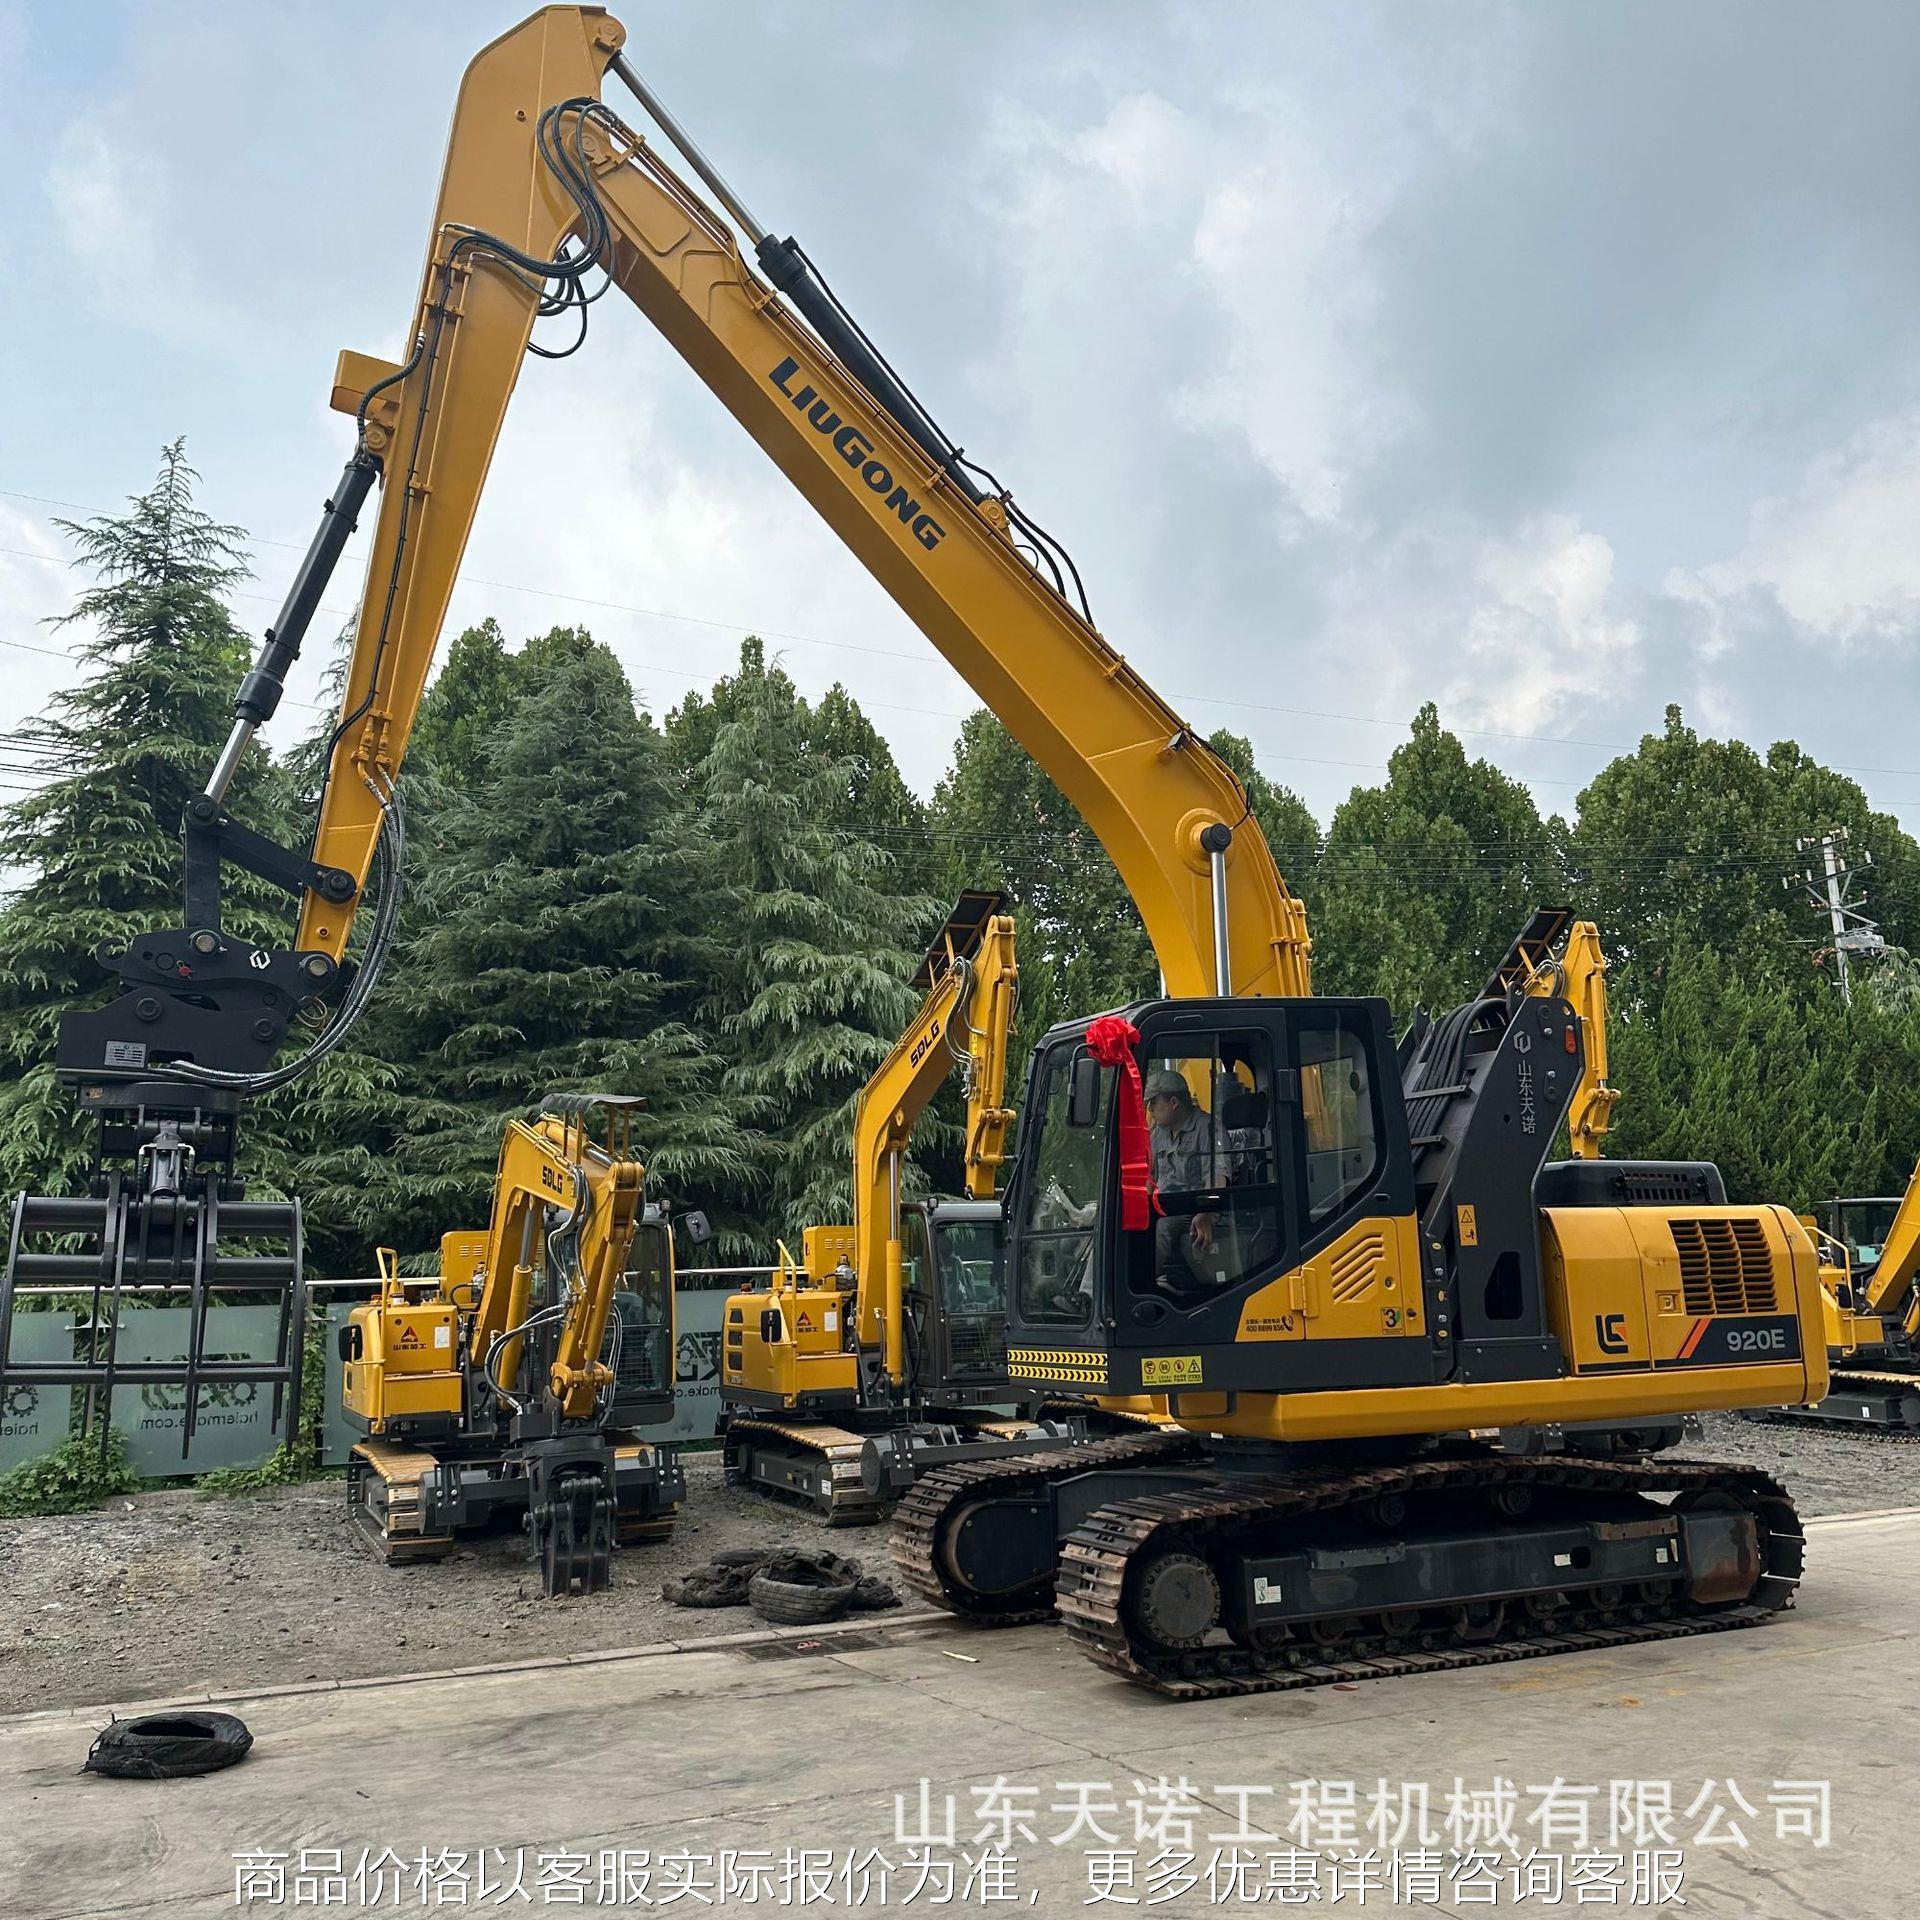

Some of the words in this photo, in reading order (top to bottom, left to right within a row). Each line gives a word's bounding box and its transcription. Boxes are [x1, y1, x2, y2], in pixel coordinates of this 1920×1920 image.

[769, 356, 946, 551] LIUGONG
[909, 1019, 940, 1069] SDLG
[1518, 1060, 1537, 1134] 山东天诺
[542, 1165, 563, 1195] SDLG
[1727, 1328, 1786, 1351] 920E
